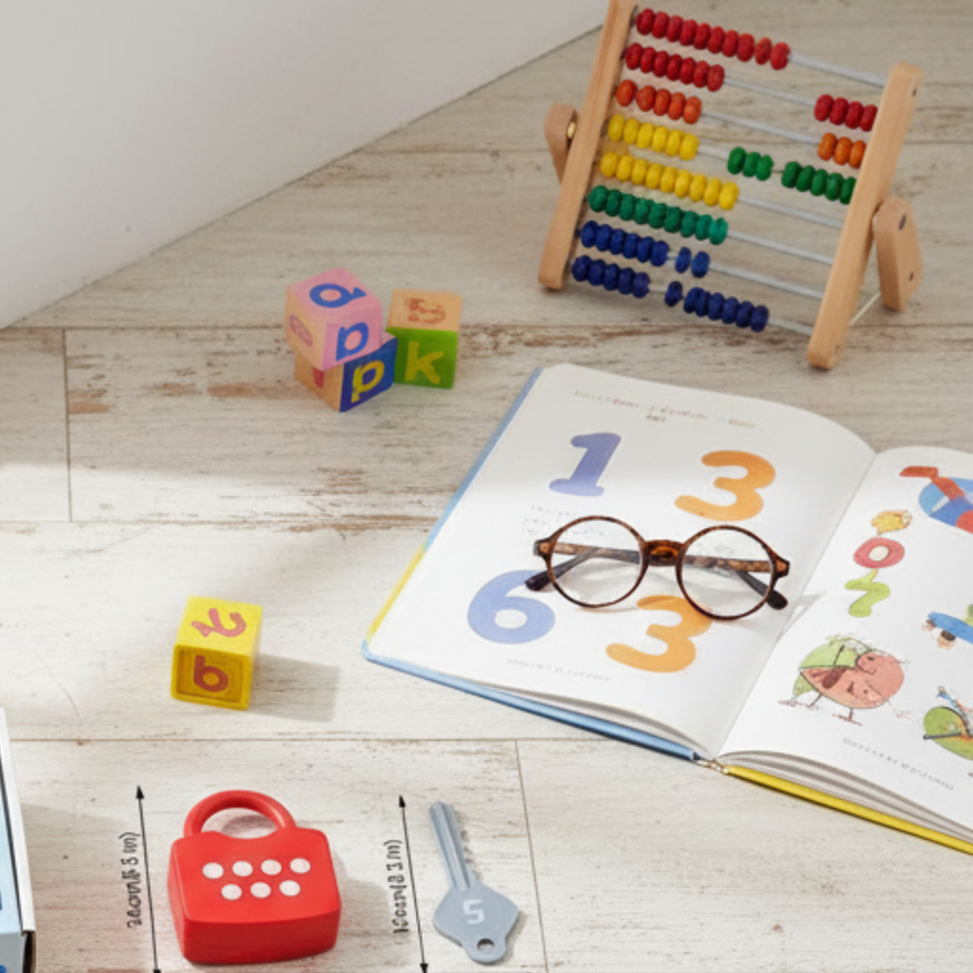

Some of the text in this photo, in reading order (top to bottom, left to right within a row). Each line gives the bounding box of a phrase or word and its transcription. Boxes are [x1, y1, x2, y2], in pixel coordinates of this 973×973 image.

[548, 432, 622, 497] 1
[674, 450, 776, 522] 3
[466, 569, 713, 673] 6 3
